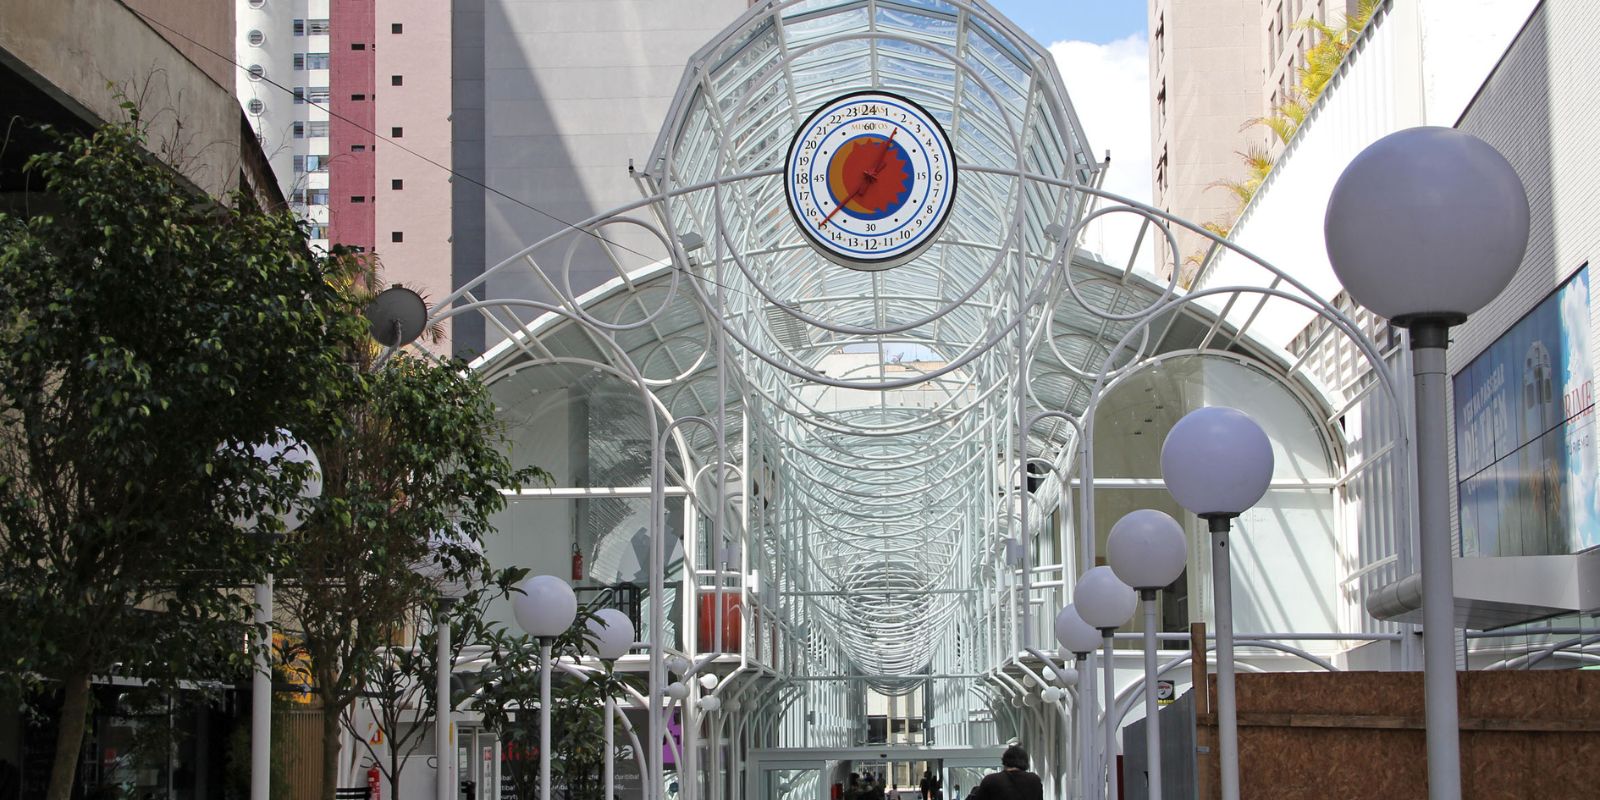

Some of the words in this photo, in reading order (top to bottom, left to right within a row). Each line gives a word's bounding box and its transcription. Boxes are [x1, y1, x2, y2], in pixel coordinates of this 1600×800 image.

[846, 108, 858, 117] 23
[862, 104, 876, 116] 24
[884, 108, 888, 117] 1
[831, 115, 841, 124] 22
[901, 114, 907, 122] 2
[816, 127, 827, 135] 21
[915, 125, 921, 133] 3
[805, 141, 817, 149] 20
[799, 157, 809, 165] 19
[934, 154, 939, 162] 5
[796, 172, 808, 184] 18
[814, 174, 824, 182] 45
[934, 172, 942, 181] 6
[799, 192, 809, 200] 17
[933, 189, 939, 198] 7
[807, 208, 816, 216] 16
[927, 206, 932, 214] 8
[916, 219, 922, 228] 9
[831, 232, 841, 241] 14
[900, 230, 910, 239] 10
[848, 238, 858, 247] 13
[864, 239, 877, 250] 12
[884, 238, 893, 246] 11
[1564, 380, 1593, 425] RIME
